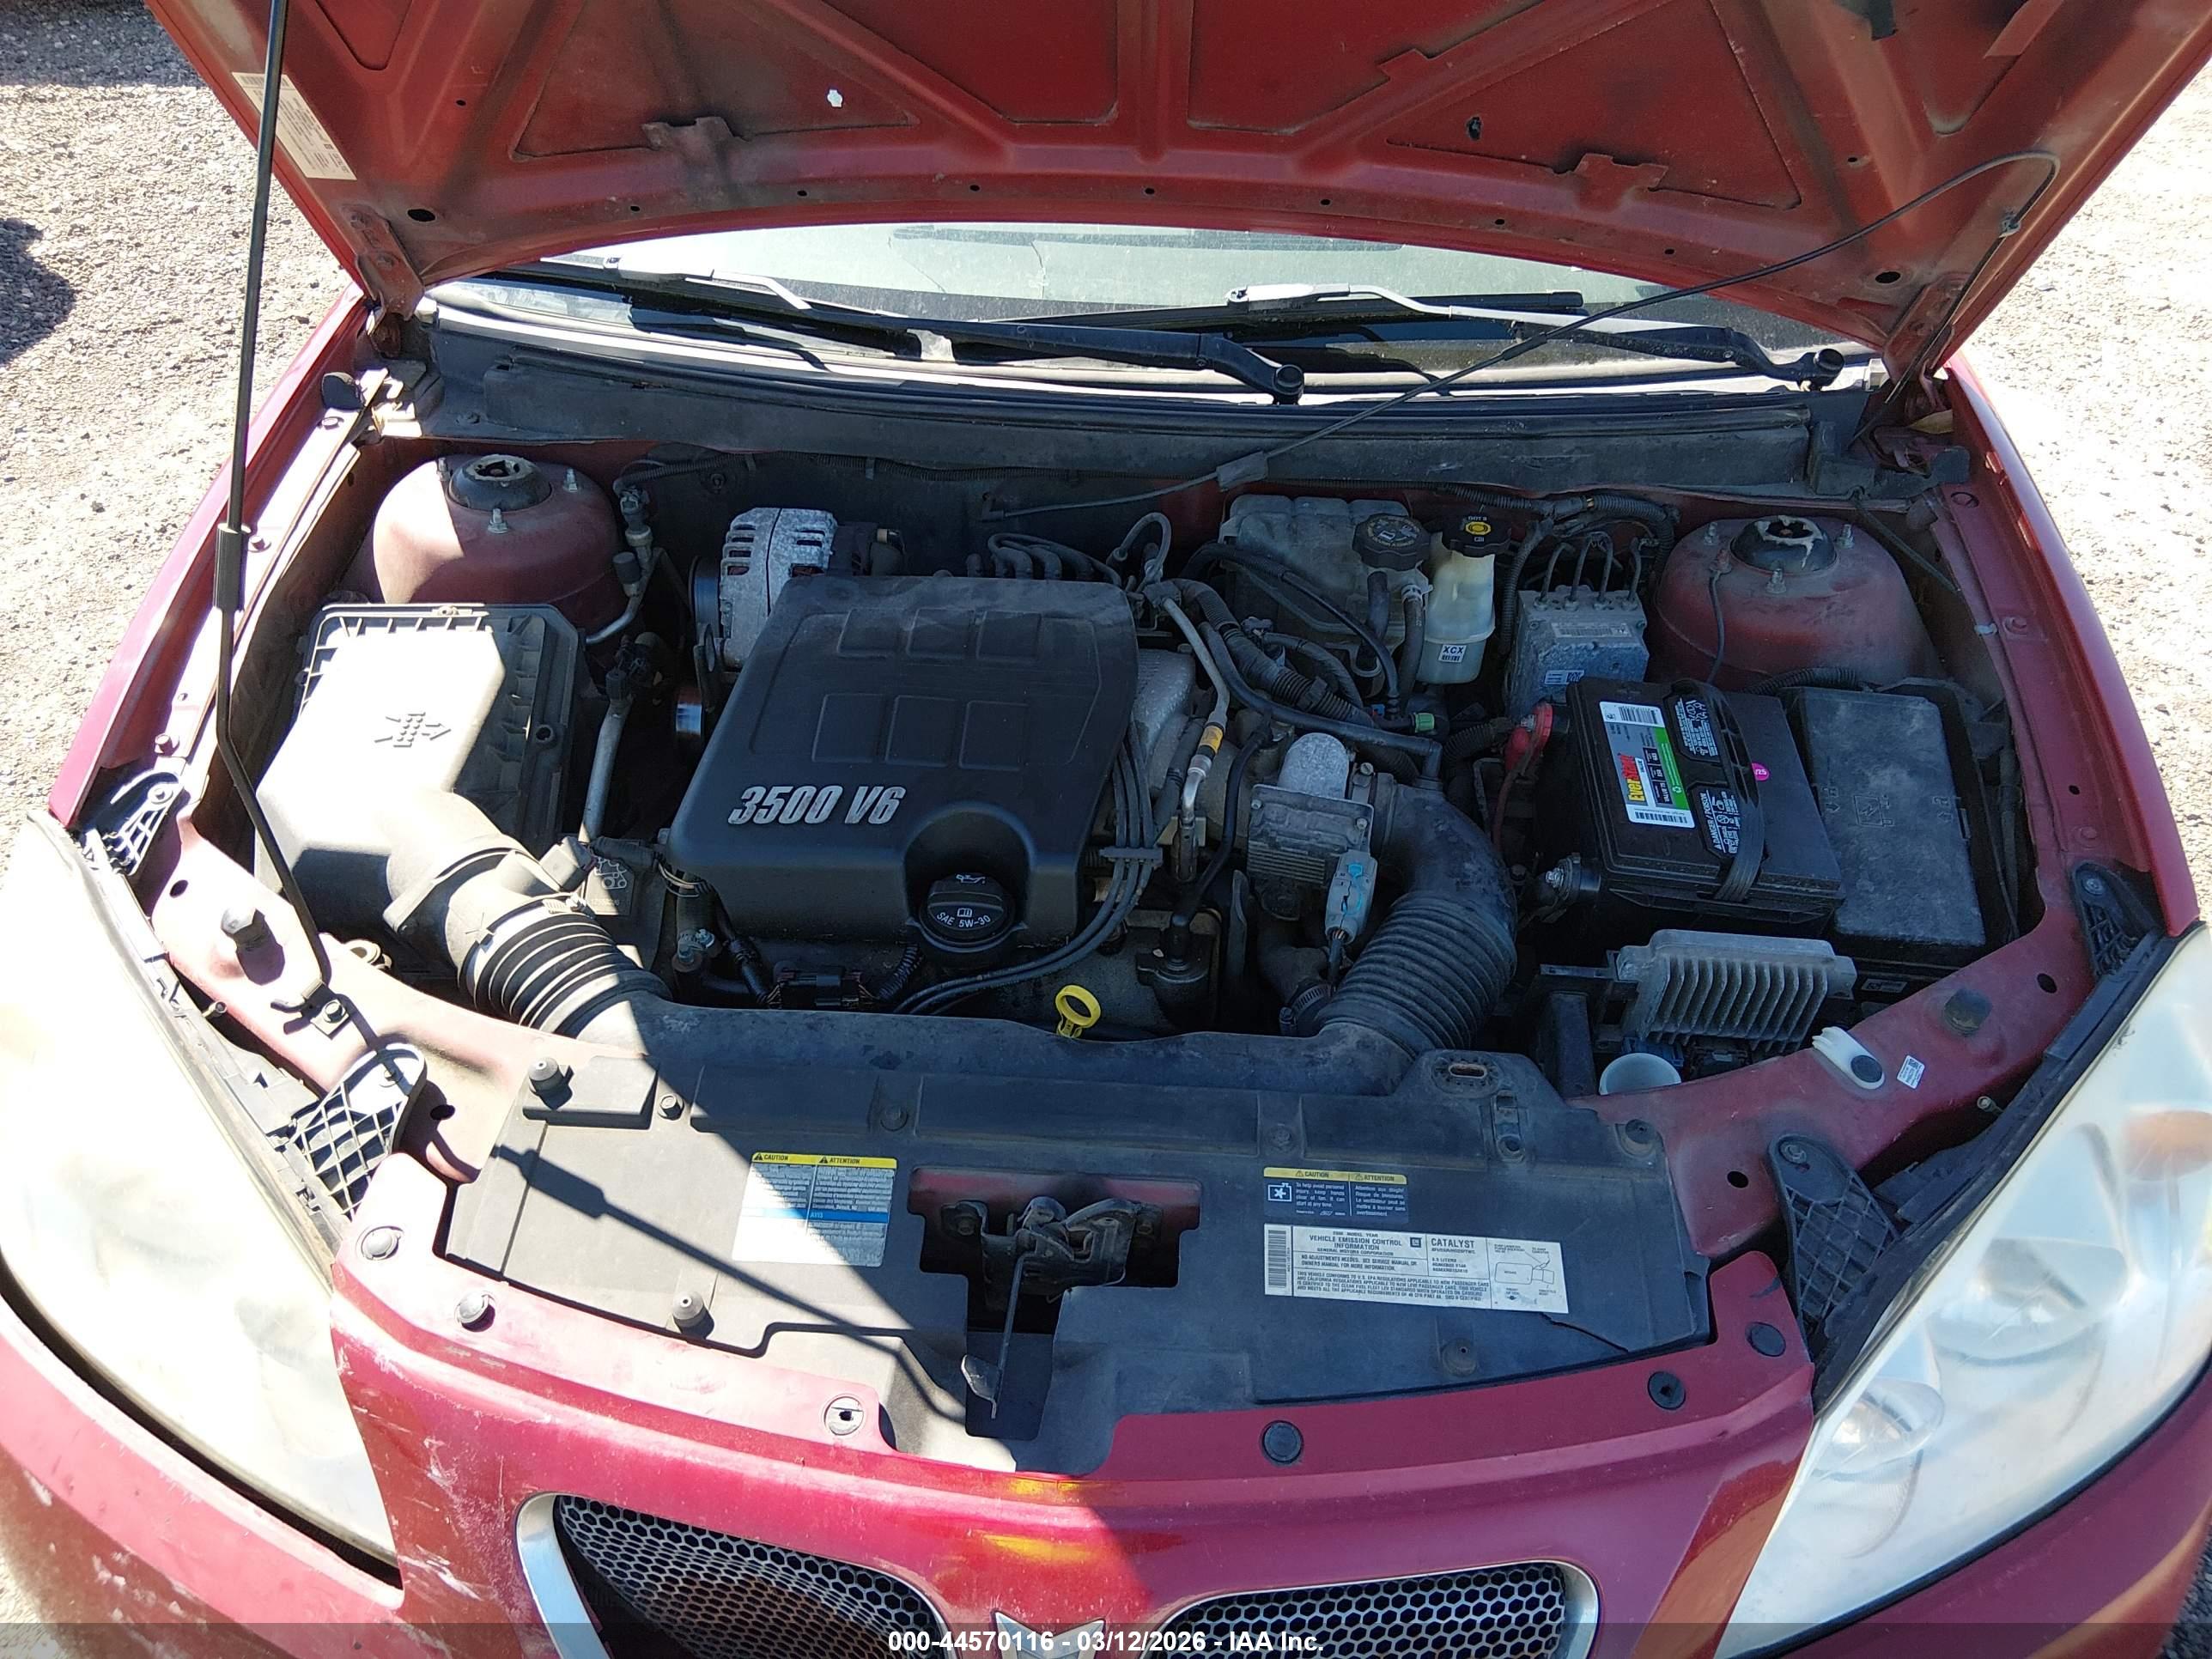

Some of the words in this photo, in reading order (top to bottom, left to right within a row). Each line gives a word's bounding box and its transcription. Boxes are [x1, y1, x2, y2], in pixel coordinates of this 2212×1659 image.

[728, 786, 843, 824] 3500
[845, 786, 906, 824] V6
[1700, 793, 1712, 814] POISON
[1707, 819, 1720, 843] DANGER
[936, 912, 954, 927] SAE
[958, 914, 992, 929] 5W-30
[1431, 1238, 1475, 1249] CATALYST
